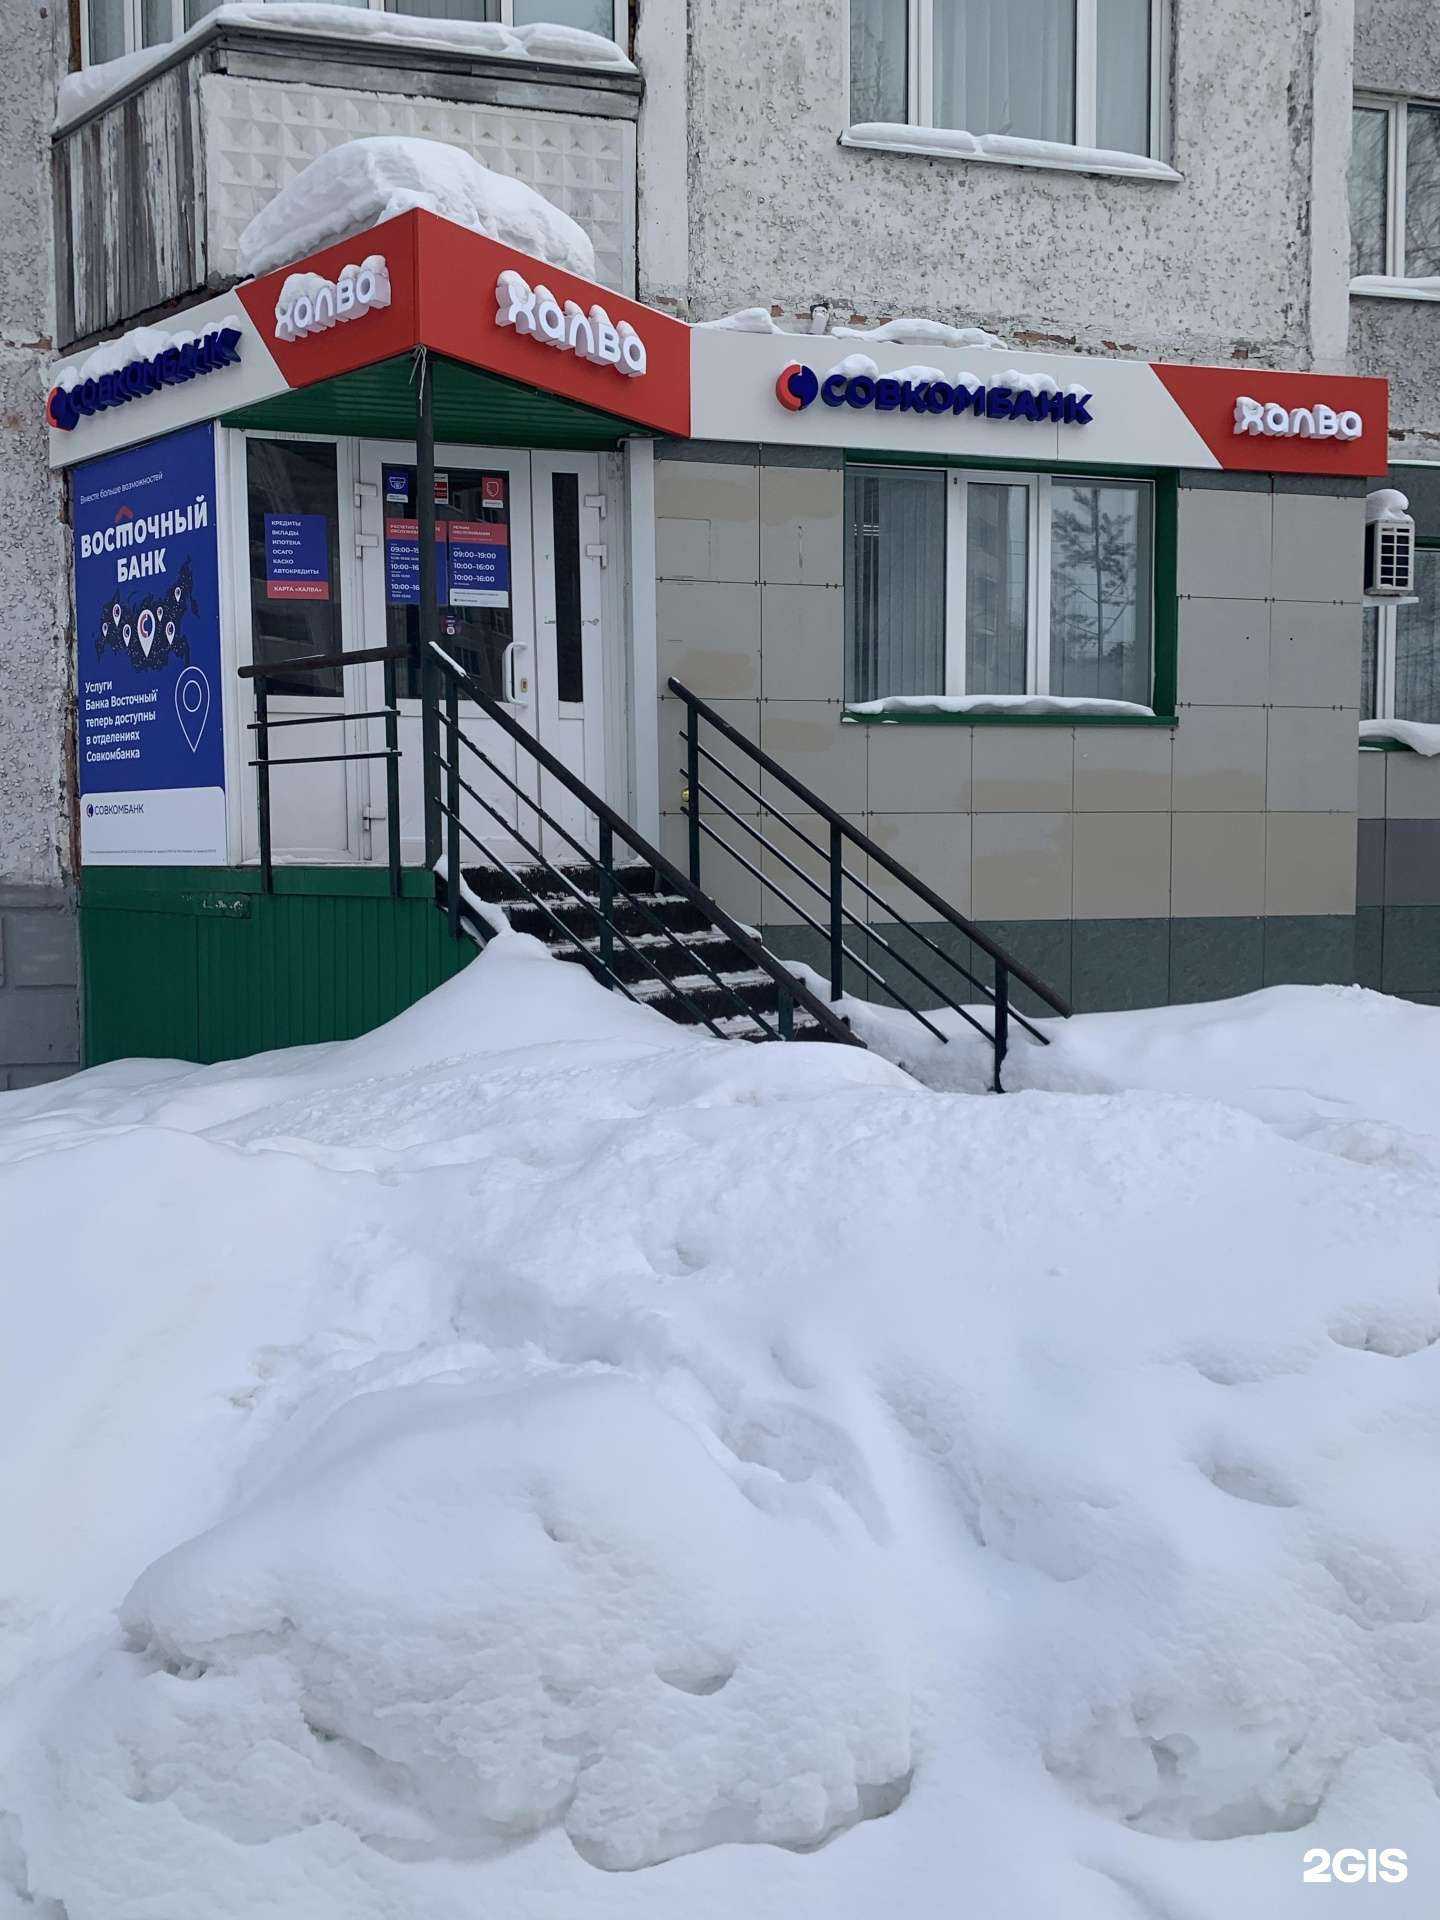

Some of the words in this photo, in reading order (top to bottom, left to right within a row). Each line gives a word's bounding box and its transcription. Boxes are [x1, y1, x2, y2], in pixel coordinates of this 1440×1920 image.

[821, 372, 1093, 425] СОВКОМБАНК
[80, 492, 100, 505] Вместе
[100, 486, 121, 499] больше
[121, 471, 163, 492] возможностей
[81, 494, 208, 558] ВОСТОЧНЫЙ
[117, 547, 166, 583] БАНК
[85, 680, 113, 694] Услуги
[85, 697, 109, 711] Банка
[85, 715, 113, 728] теперь
[114, 709, 156, 727] доступны
[86, 736, 91, 745] в
[92, 730, 140, 745] отделениях
[86, 748, 140, 763] Совкомбанка
[94, 804, 144, 816] СОВКОМБАНК
